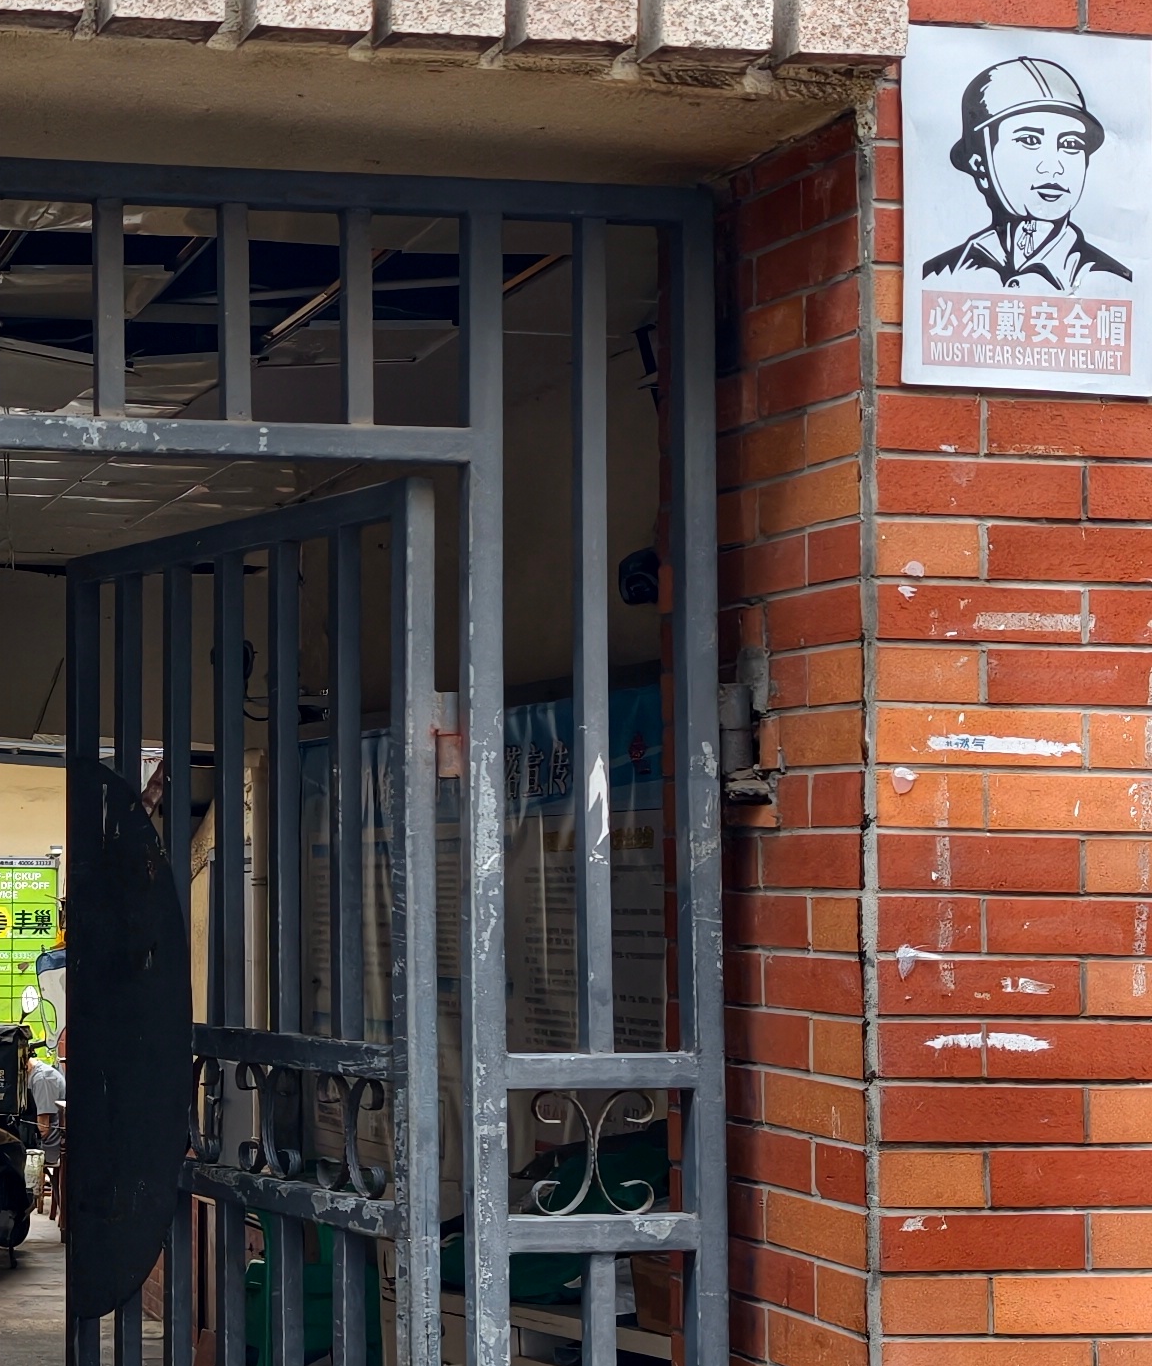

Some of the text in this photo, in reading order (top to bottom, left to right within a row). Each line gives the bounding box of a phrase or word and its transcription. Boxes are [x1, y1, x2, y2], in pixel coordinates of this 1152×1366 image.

[929, 297, 1127, 347] 必须戴安全帽
[930, 342, 1123, 371] MUST WEAR SAFETY HELMET
[1, 881, 50, 890] DROP-OFF
[13, 909, 52, 935] 丰巢
